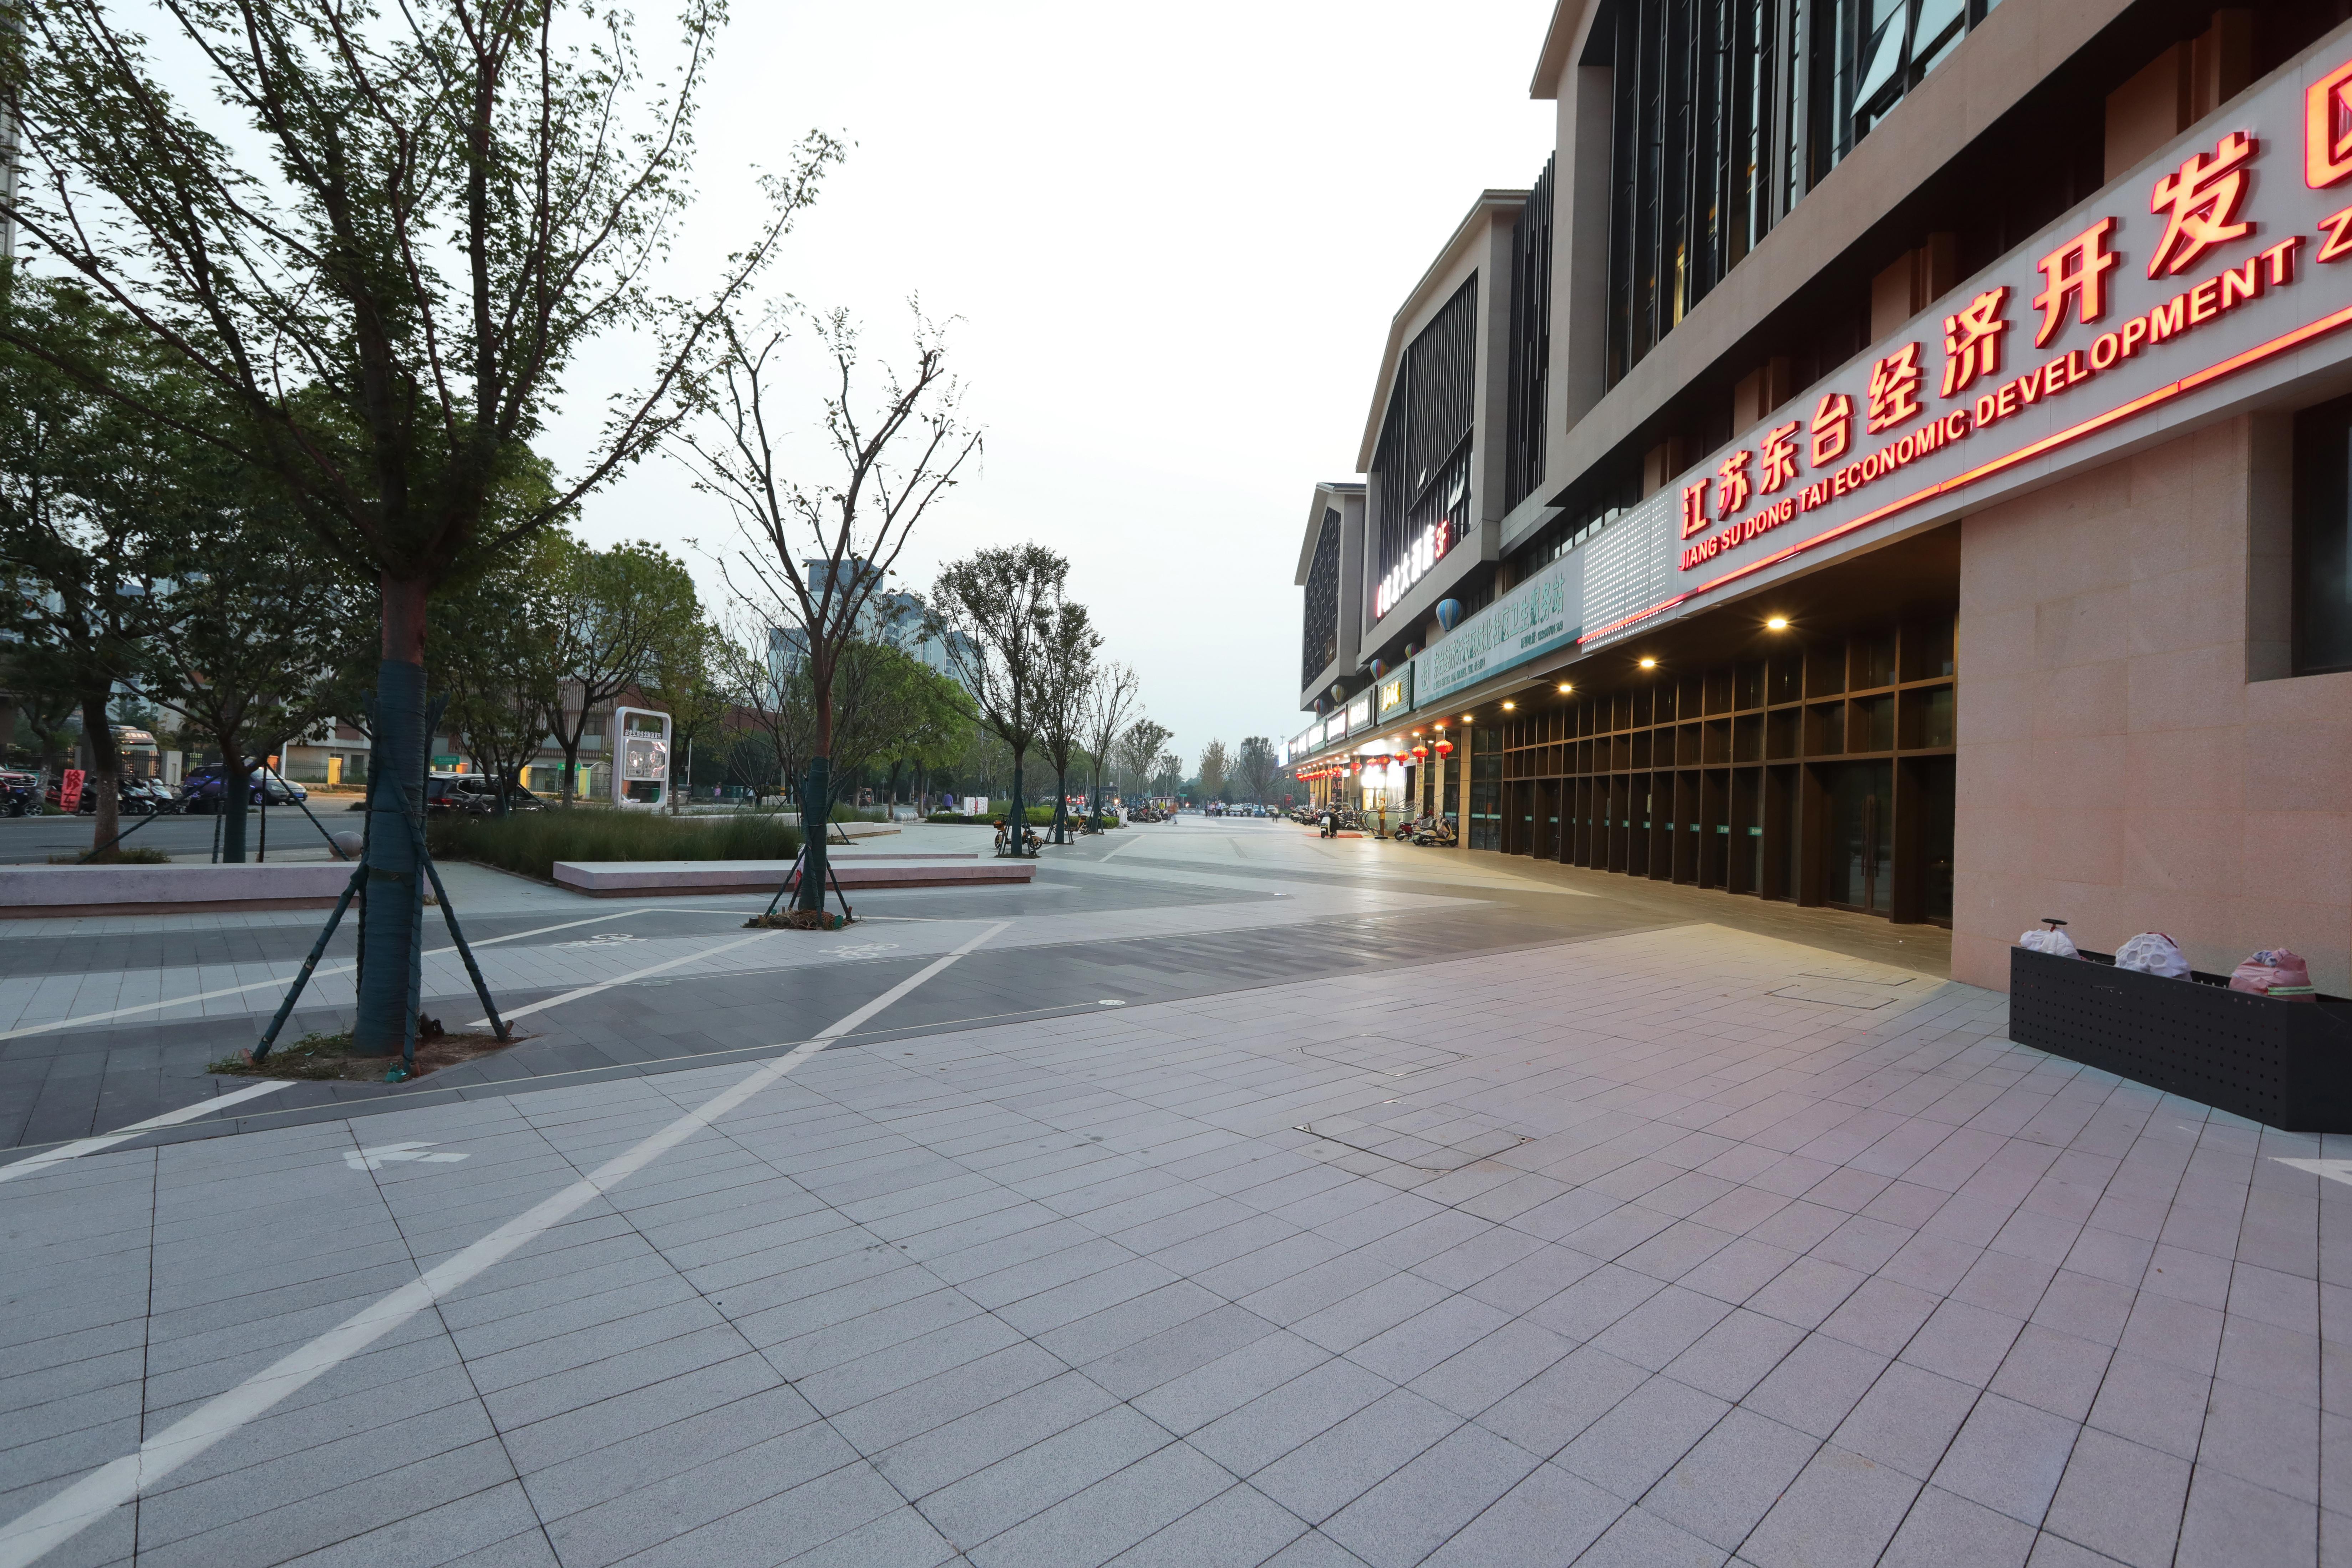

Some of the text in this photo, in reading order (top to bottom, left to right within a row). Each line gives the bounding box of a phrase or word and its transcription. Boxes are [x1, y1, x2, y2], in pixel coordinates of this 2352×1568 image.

[1678, 536, 1721, 571] JIANG
[1721, 522, 1745, 550] SU
[1744, 497, 1797, 540] DONG
[1797, 478, 1833, 512] TAI
[1833, 409, 1972, 496] ECONOMIC
[1975, 235, 2306, 428] DEVELOPMENT
[1436, 520, 1448, 558] 3F
[1433, 572, 1565, 679] 东台经济开发区城北社区卫生服务站
[60, 770, 81, 811] 修车
[1332, 780, 1342, 790] 入口
